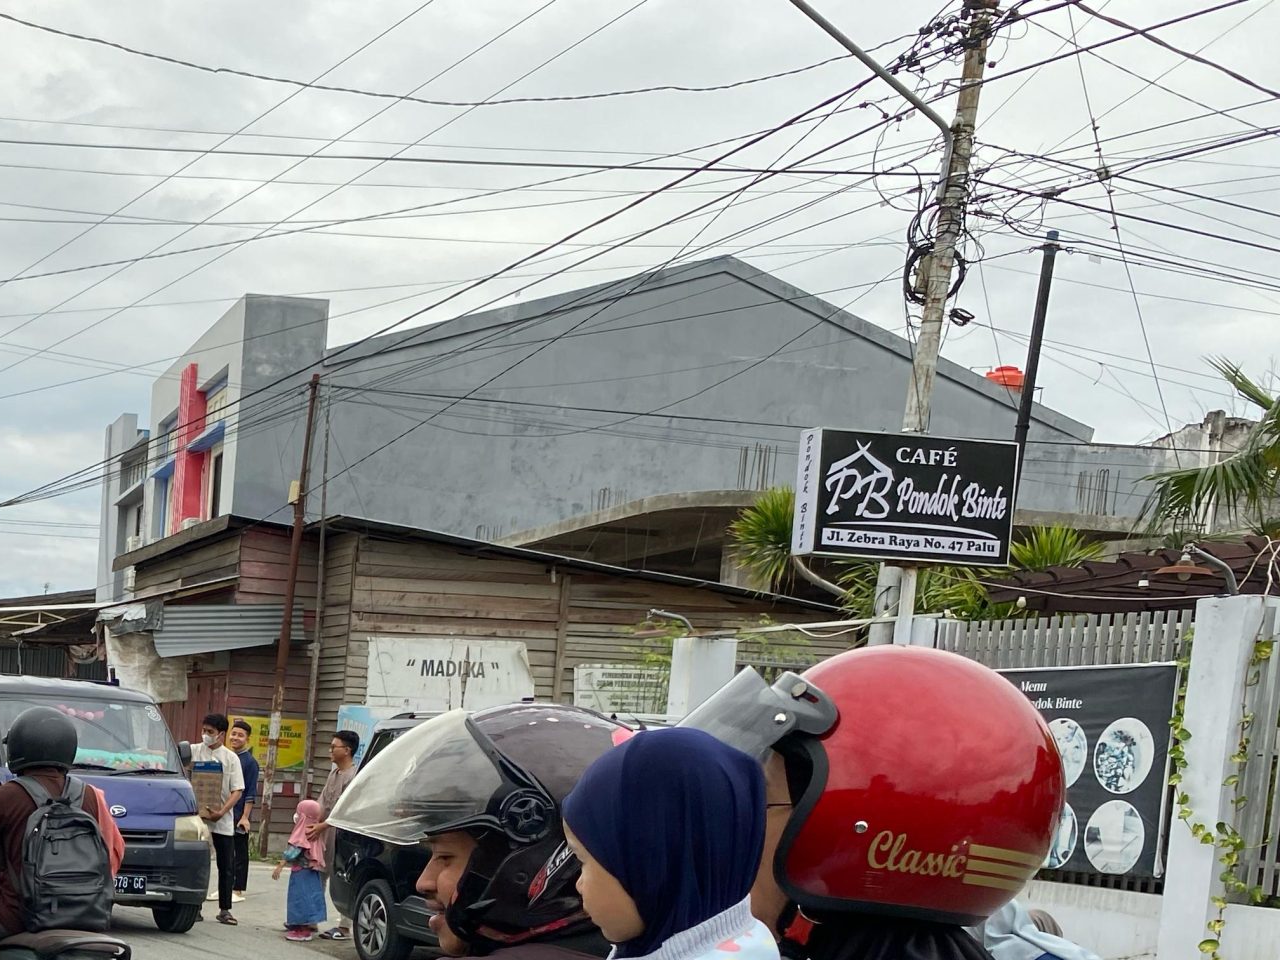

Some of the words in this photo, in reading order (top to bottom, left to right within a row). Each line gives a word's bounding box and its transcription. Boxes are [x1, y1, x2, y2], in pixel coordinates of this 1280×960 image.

[895, 446, 958, 467] CAFÉ
[896, 473, 960, 522] Pondok
[961, 482, 1008, 520] Binte
[826, 530, 844, 542] Jl.
[847, 531, 885, 545] Zebra
[888, 535, 920, 550] Raya
[923, 538, 945, 549] No.
[947, 541, 963, 552] 47
[966, 541, 995, 553] Palu
[1020, 681, 1048, 692] Menu
[1031, 698, 1054, 710] ndok
[1055, 697, 1083, 709] Binte
[867, 830, 968, 878] Classic
[133, 877, 144, 889] GC
